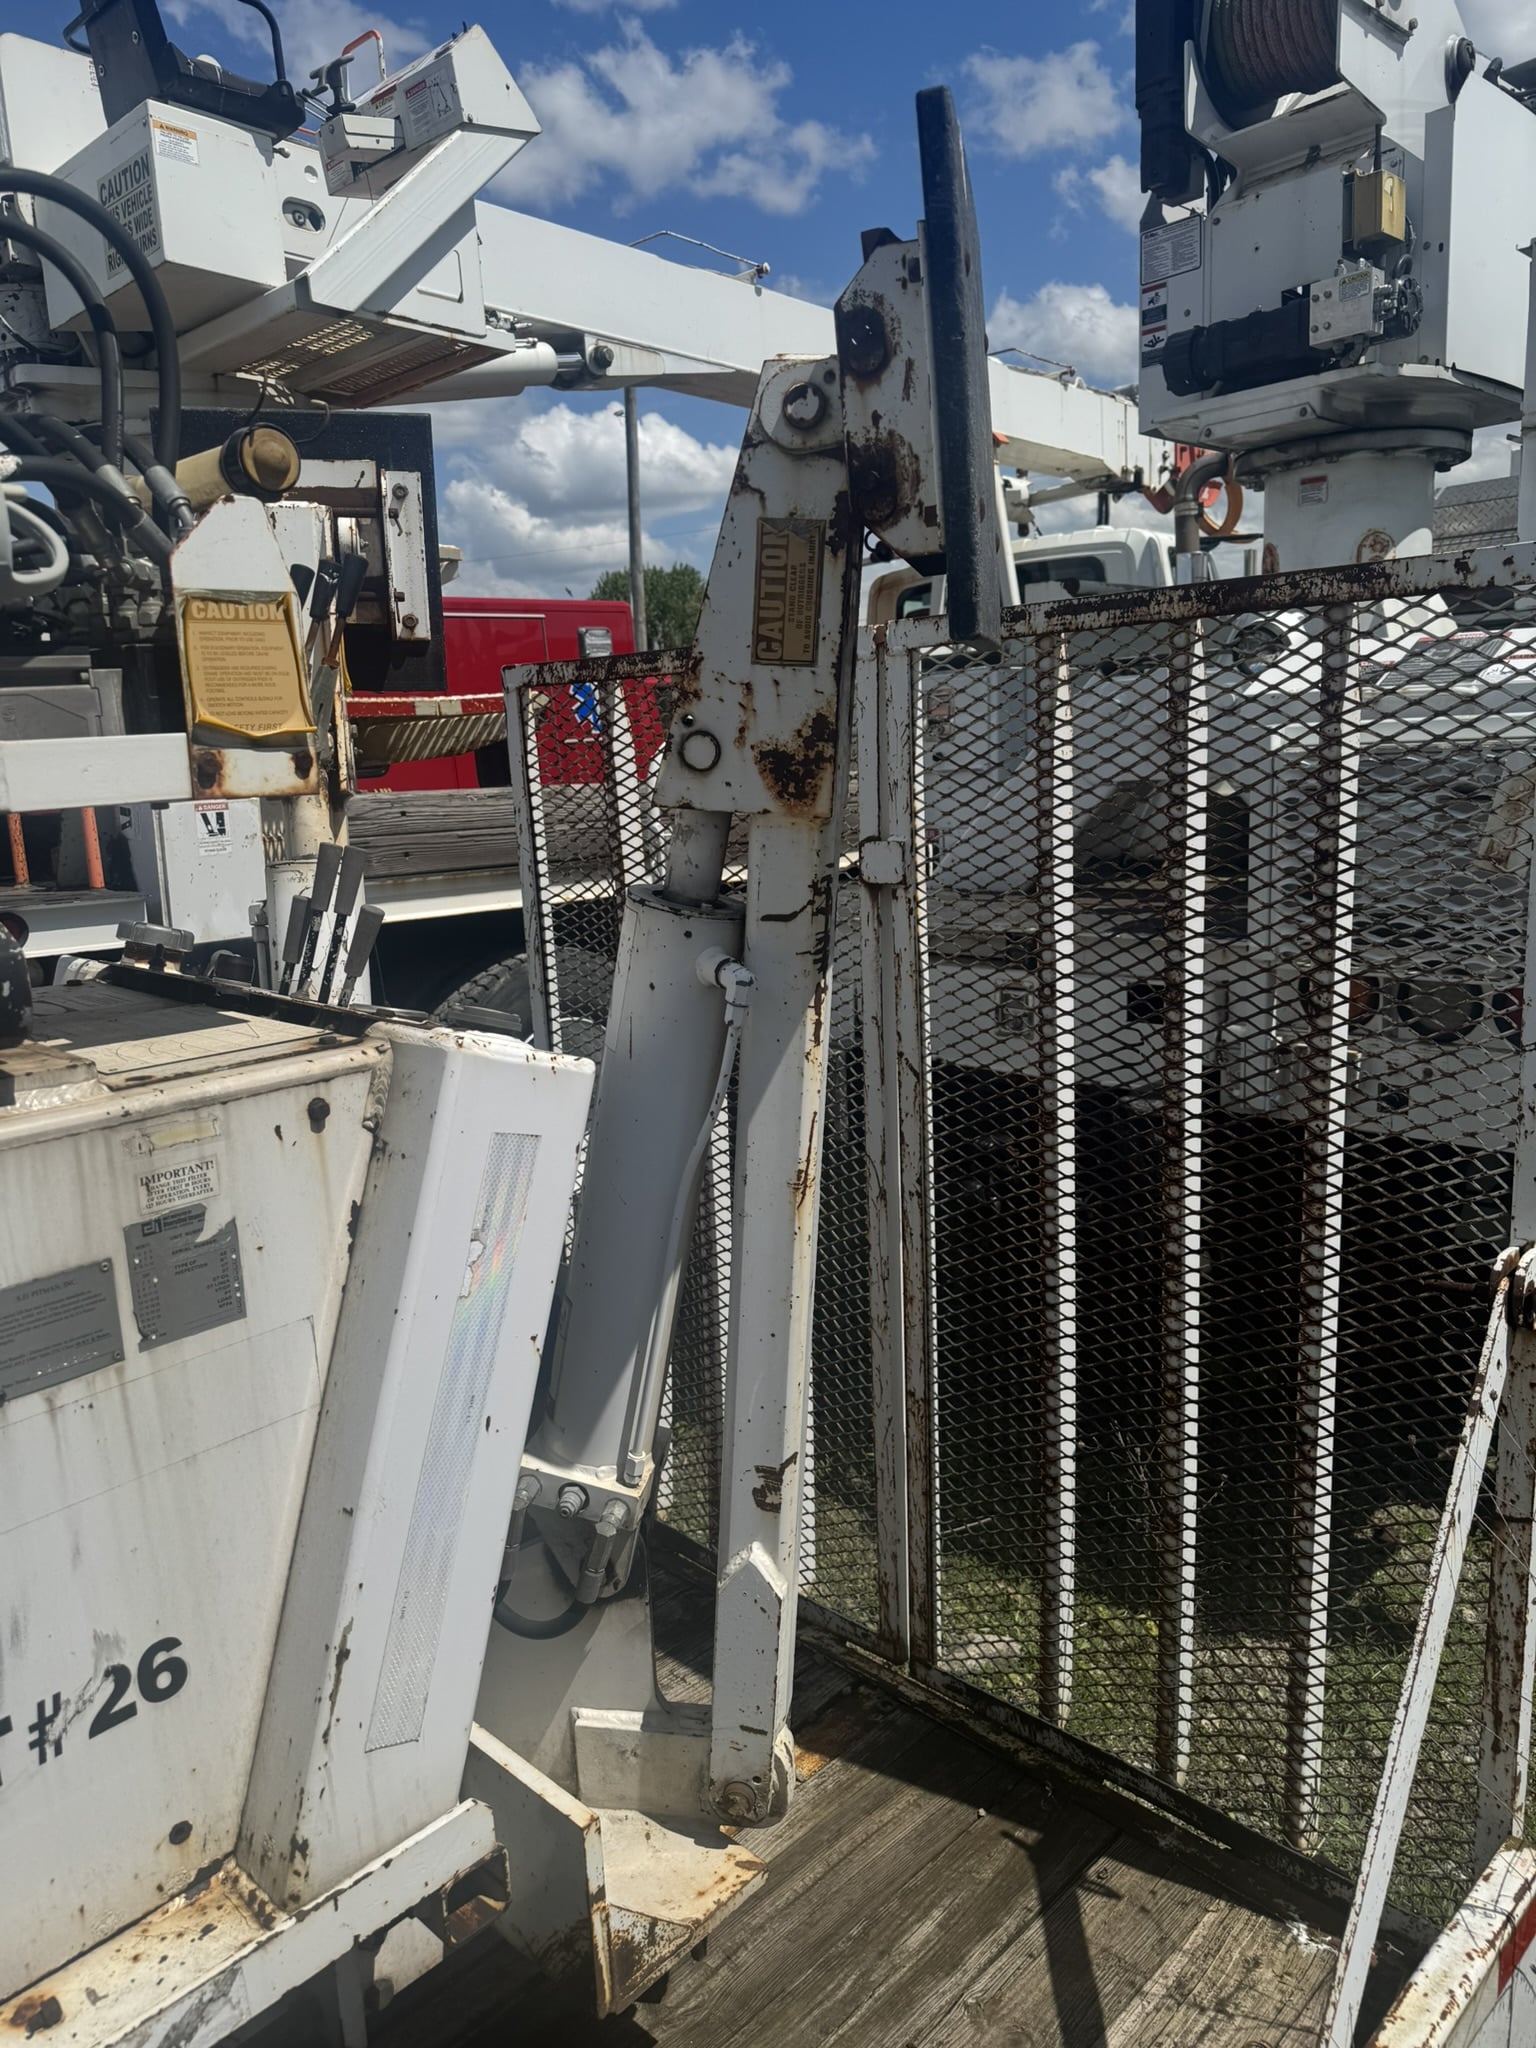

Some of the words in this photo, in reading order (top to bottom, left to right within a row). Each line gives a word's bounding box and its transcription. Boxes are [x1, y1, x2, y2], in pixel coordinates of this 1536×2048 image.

[100, 153, 150, 206] CAUTION
[120, 184, 153, 219] VEHICLE
[133, 207, 153, 234] WIDE
[808, 534, 816, 565] INJURY
[788, 564, 797, 592] CLEAR
[805, 568, 815, 611] CRUSHING
[787, 594, 796, 623] STAND
[796, 618, 803, 630] OF
[804, 614, 812, 641] AVOID
[803, 643, 811, 654] TO
[140, 1160, 214, 1187] IMPORTANT!
[172, 1178, 186, 1186] THIS
[188, 1172, 207, 1182] FILTER
[193, 1183, 210, 1191] EVERY
[166, 1184, 183, 1193] FIRST
